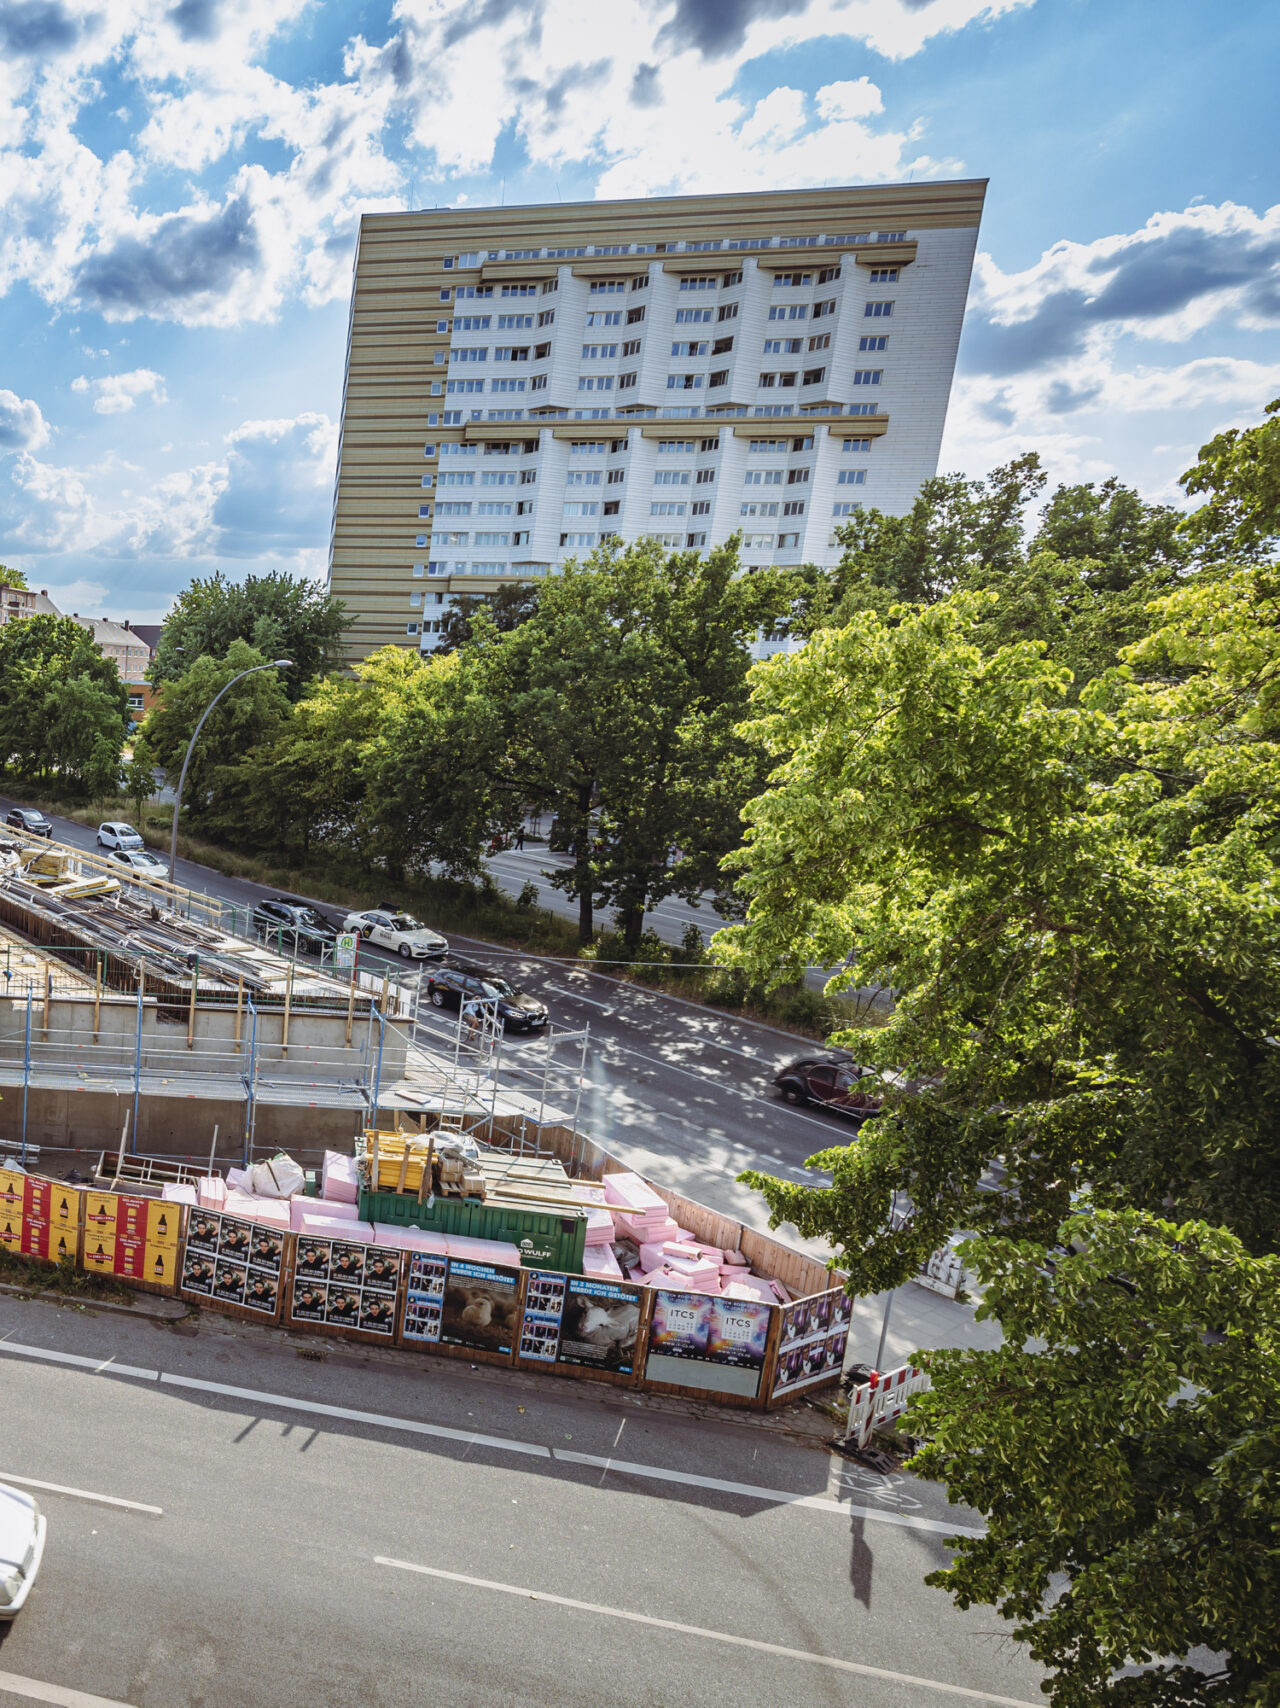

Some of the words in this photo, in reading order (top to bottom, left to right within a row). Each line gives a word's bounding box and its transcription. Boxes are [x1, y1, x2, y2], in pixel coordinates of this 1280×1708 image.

[524, 1249, 552, 1258] WULFF
[466, 1264, 494, 1274] WOCHEN
[451, 1268, 472, 1276] WERDE
[486, 1273, 514, 1283] GETÖTET
[586, 1283, 618, 1292] MONATEN
[570, 1286, 592, 1294] WERDE
[608, 1292, 636, 1302] GETÖTET
[670, 1309, 694, 1320] ITCS
[726, 1318, 750, 1328] ITCS
